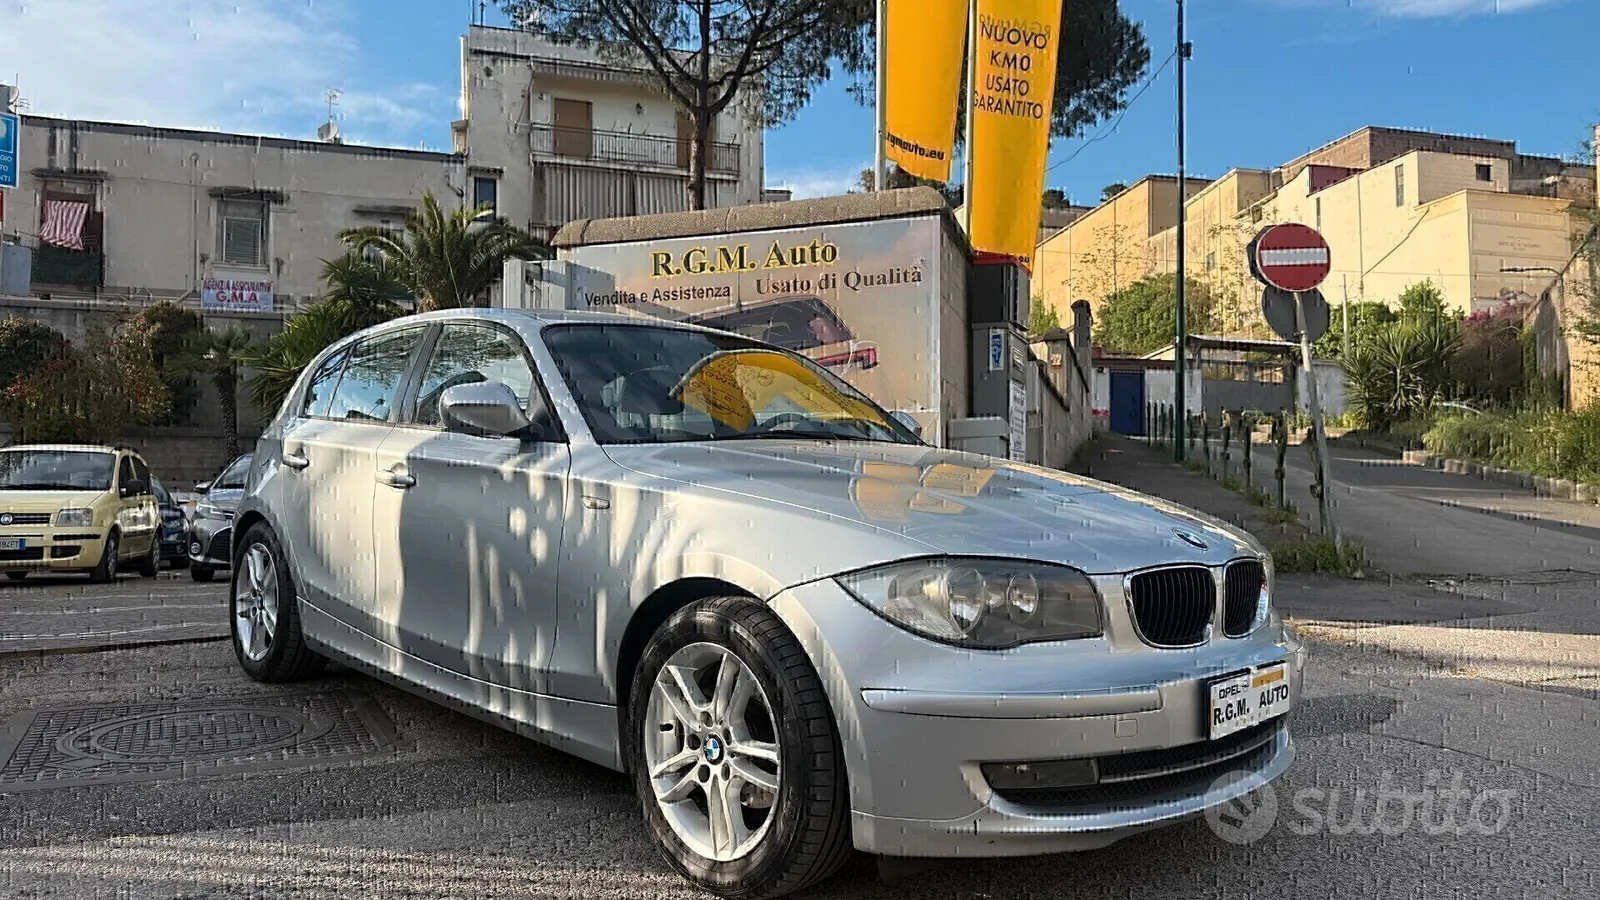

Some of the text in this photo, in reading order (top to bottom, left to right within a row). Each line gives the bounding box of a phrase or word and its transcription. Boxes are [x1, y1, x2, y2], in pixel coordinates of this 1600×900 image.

[981, 22, 1047, 49] NUOVO
[986, 74, 1029, 96] USATO
[652, 239, 839, 278] R.G.M. Auto
[756, 267, 922, 295] Usato di Qualità
[585, 285, 731, 306] Vendita e Assistenza
[1213, 684, 1289, 725] R.G.M. AUTO
[1219, 685, 1241, 699] OPEL
